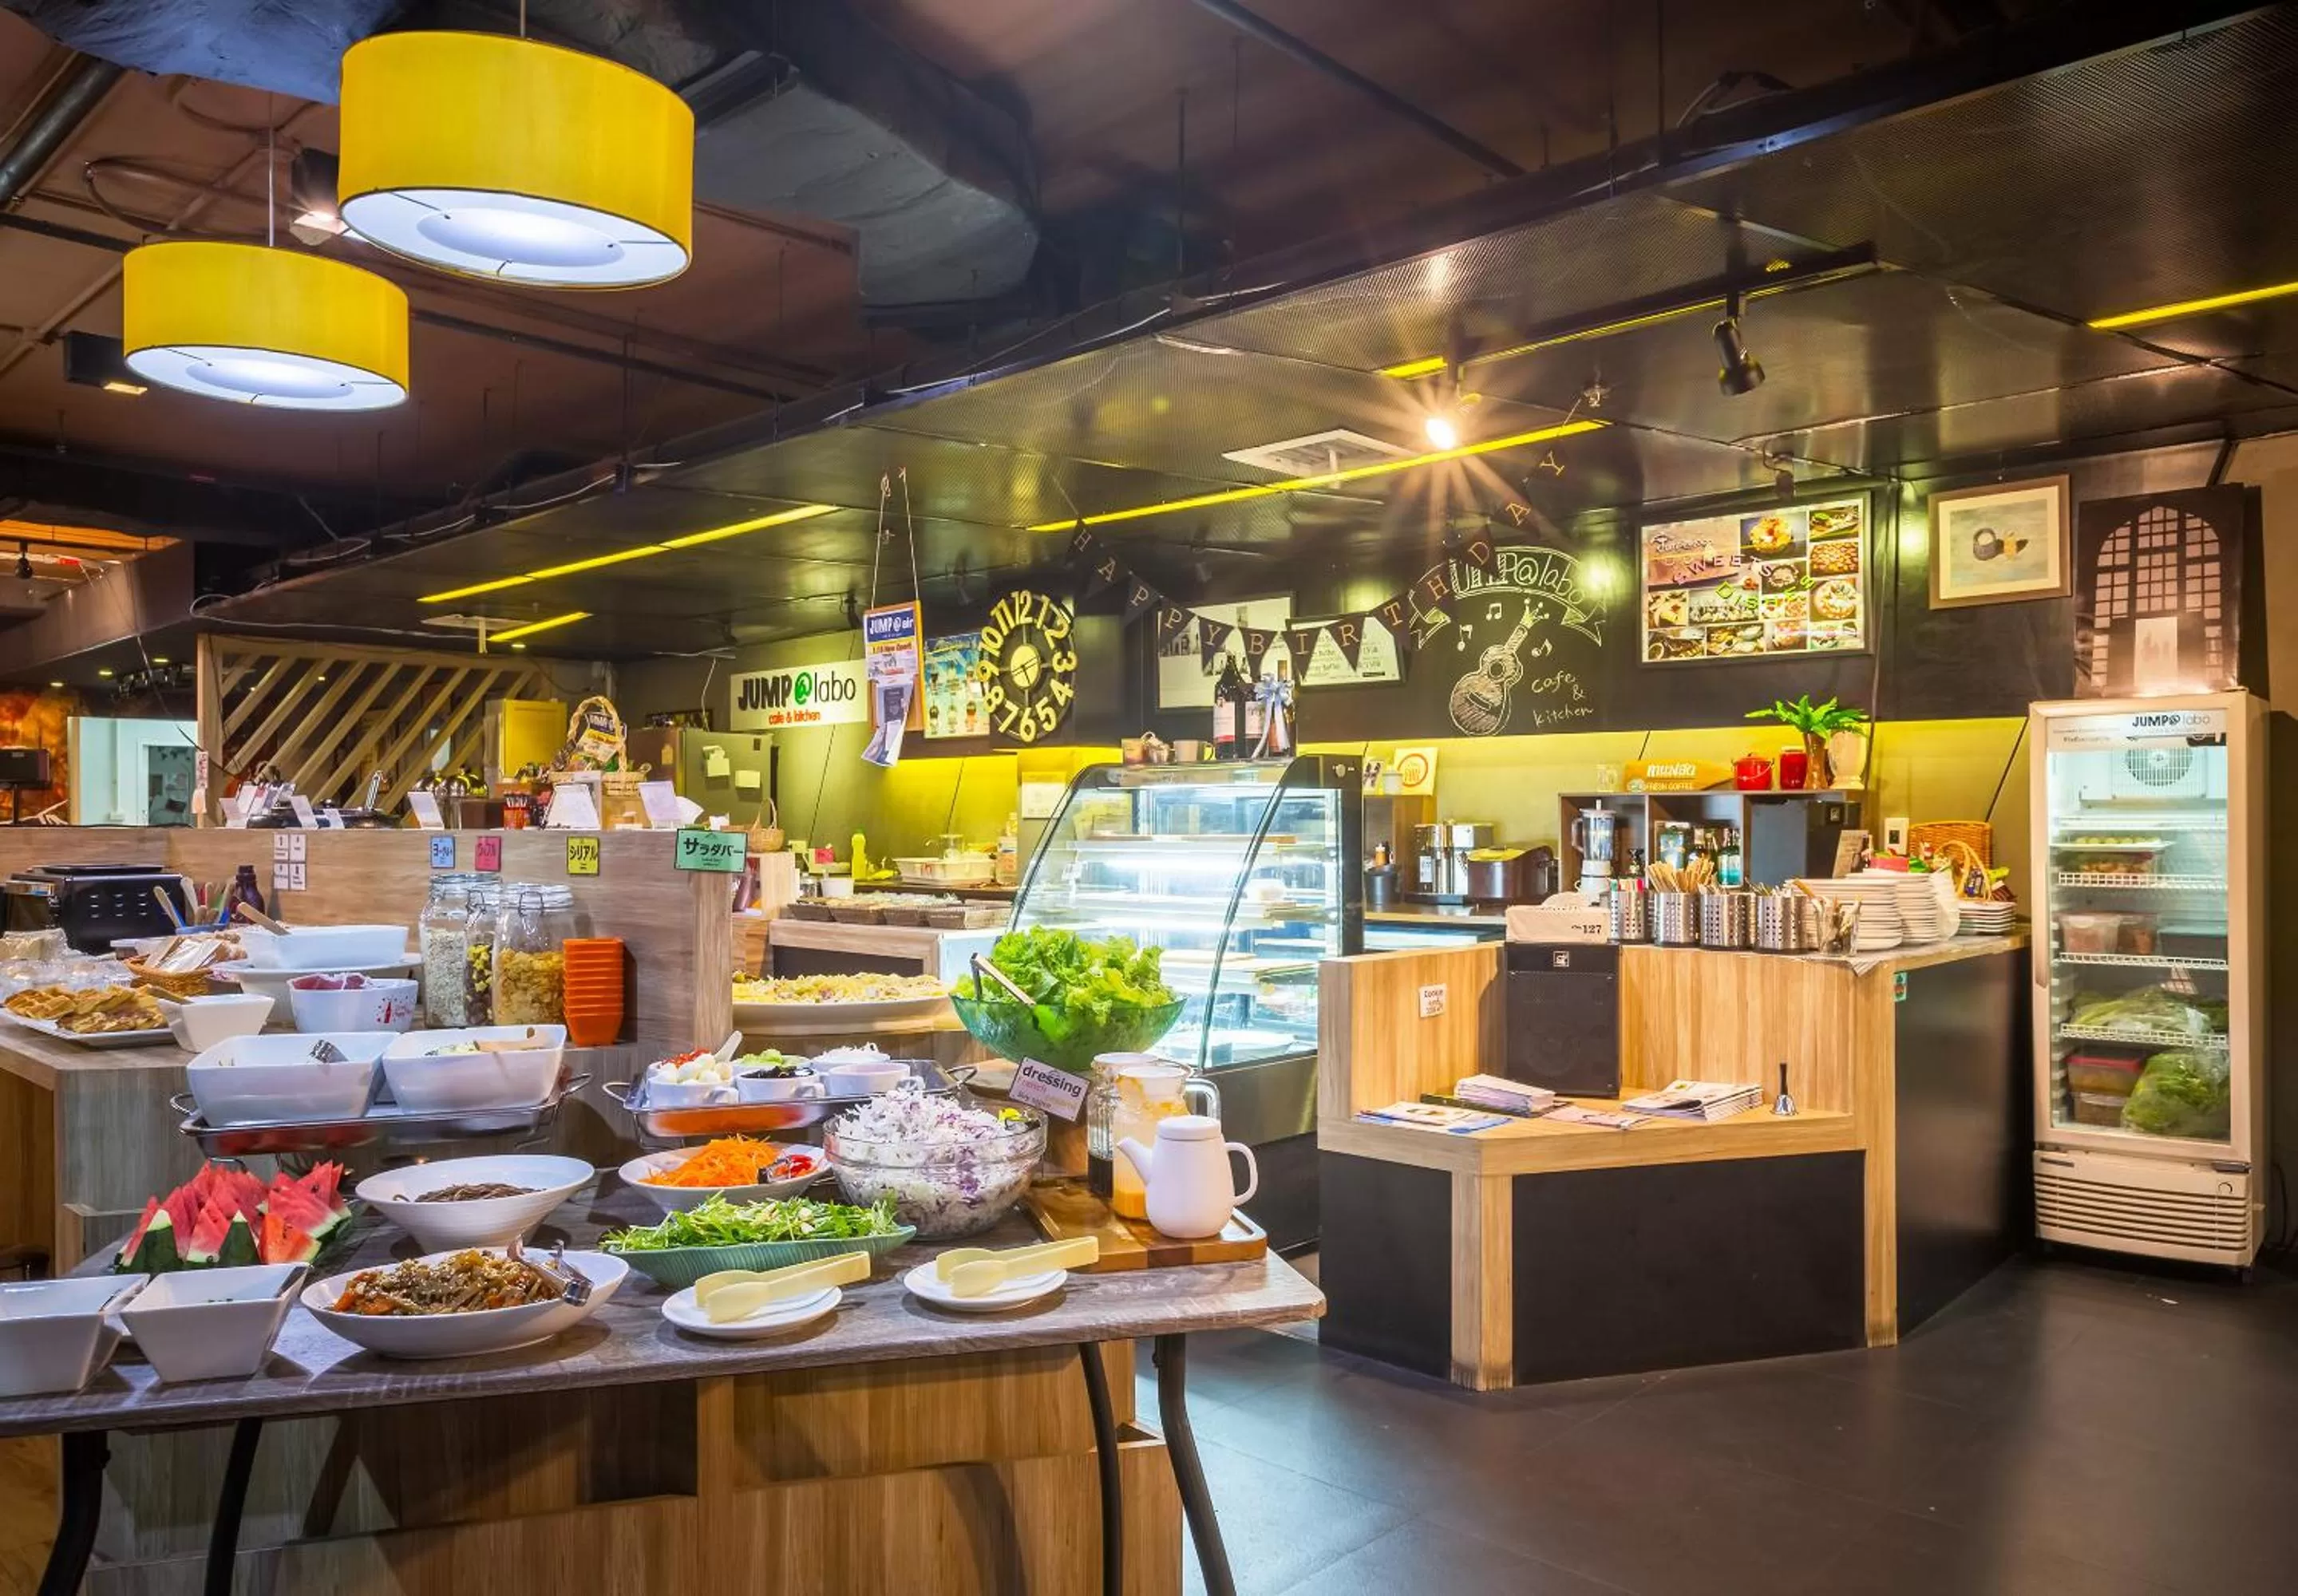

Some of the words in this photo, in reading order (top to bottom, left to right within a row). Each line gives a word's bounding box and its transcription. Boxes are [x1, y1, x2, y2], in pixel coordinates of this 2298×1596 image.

[990, 598, 1017, 636] 11
[1011, 590, 1033, 625] 12
[1034, 595, 1051, 630] 1
[979, 626, 1005, 658] 10
[1044, 611, 1071, 650] 2
[975, 660, 1000, 682] 9
[1052, 650, 1078, 674] 3
[983, 685, 1005, 714] 8
[1050, 678, 1074, 707] 4
[1572, 684, 1585, 701] &
[998, 699, 1020, 733] 7
[1019, 707, 1037, 743] 6
[1035, 696, 1058, 732] 5
[569, 845, 598, 860] シリアル
[683, 837, 743, 856] サラダバー
[1022, 1065, 1082, 1097] dressing
